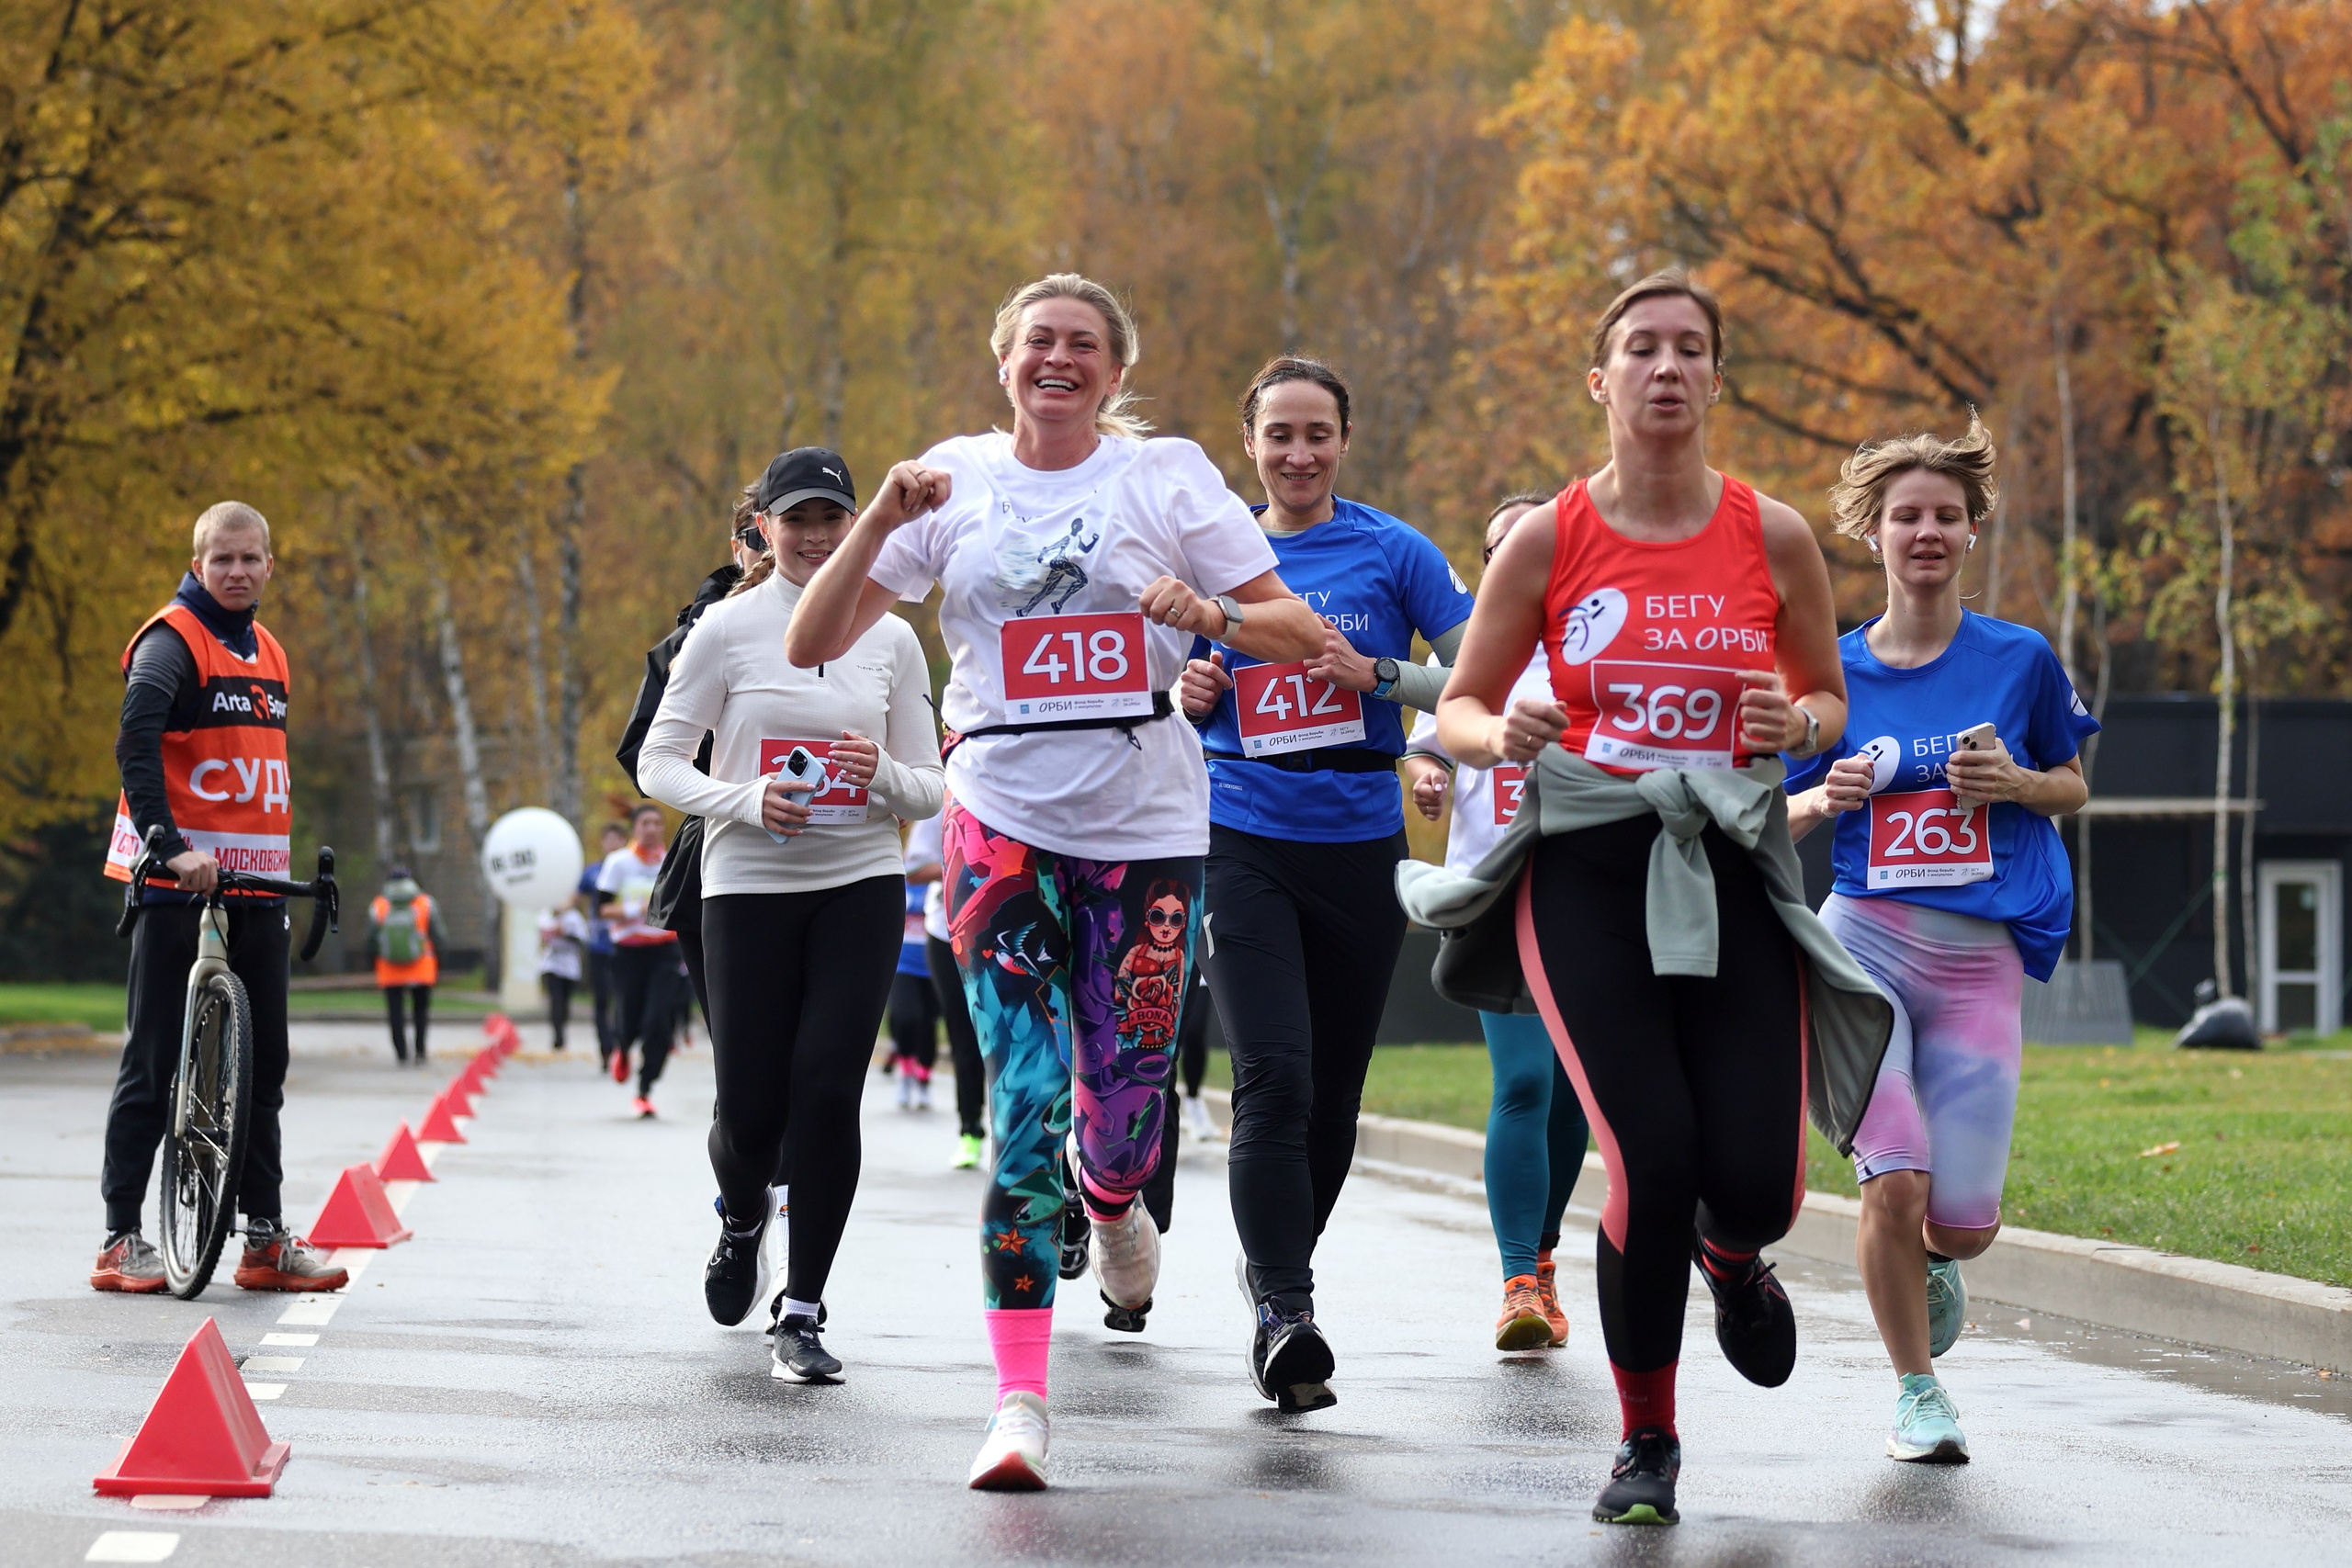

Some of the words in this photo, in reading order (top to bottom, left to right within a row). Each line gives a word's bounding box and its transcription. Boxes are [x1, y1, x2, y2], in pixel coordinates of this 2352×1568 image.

[1645, 594, 1725, 619] БЕГУ
[1644, 626, 1688, 651] ЗА
[1694, 626, 1769, 653] ОРБИ
[1022, 628, 1129, 684] 418
[212, 692, 252, 713] Arta
[1039, 700, 1073, 713] ОРБИ
[1255, 673, 1343, 721] 412
[1608, 682, 1723, 740] 369
[1269, 734, 1297, 747] ОРБИ
[1913, 734, 1958, 757] БЕГ
[1620, 747, 1656, 761] ОРБИ
[1884, 807, 1977, 857] 263
[1895, 868, 1926, 879] ОРБИ
